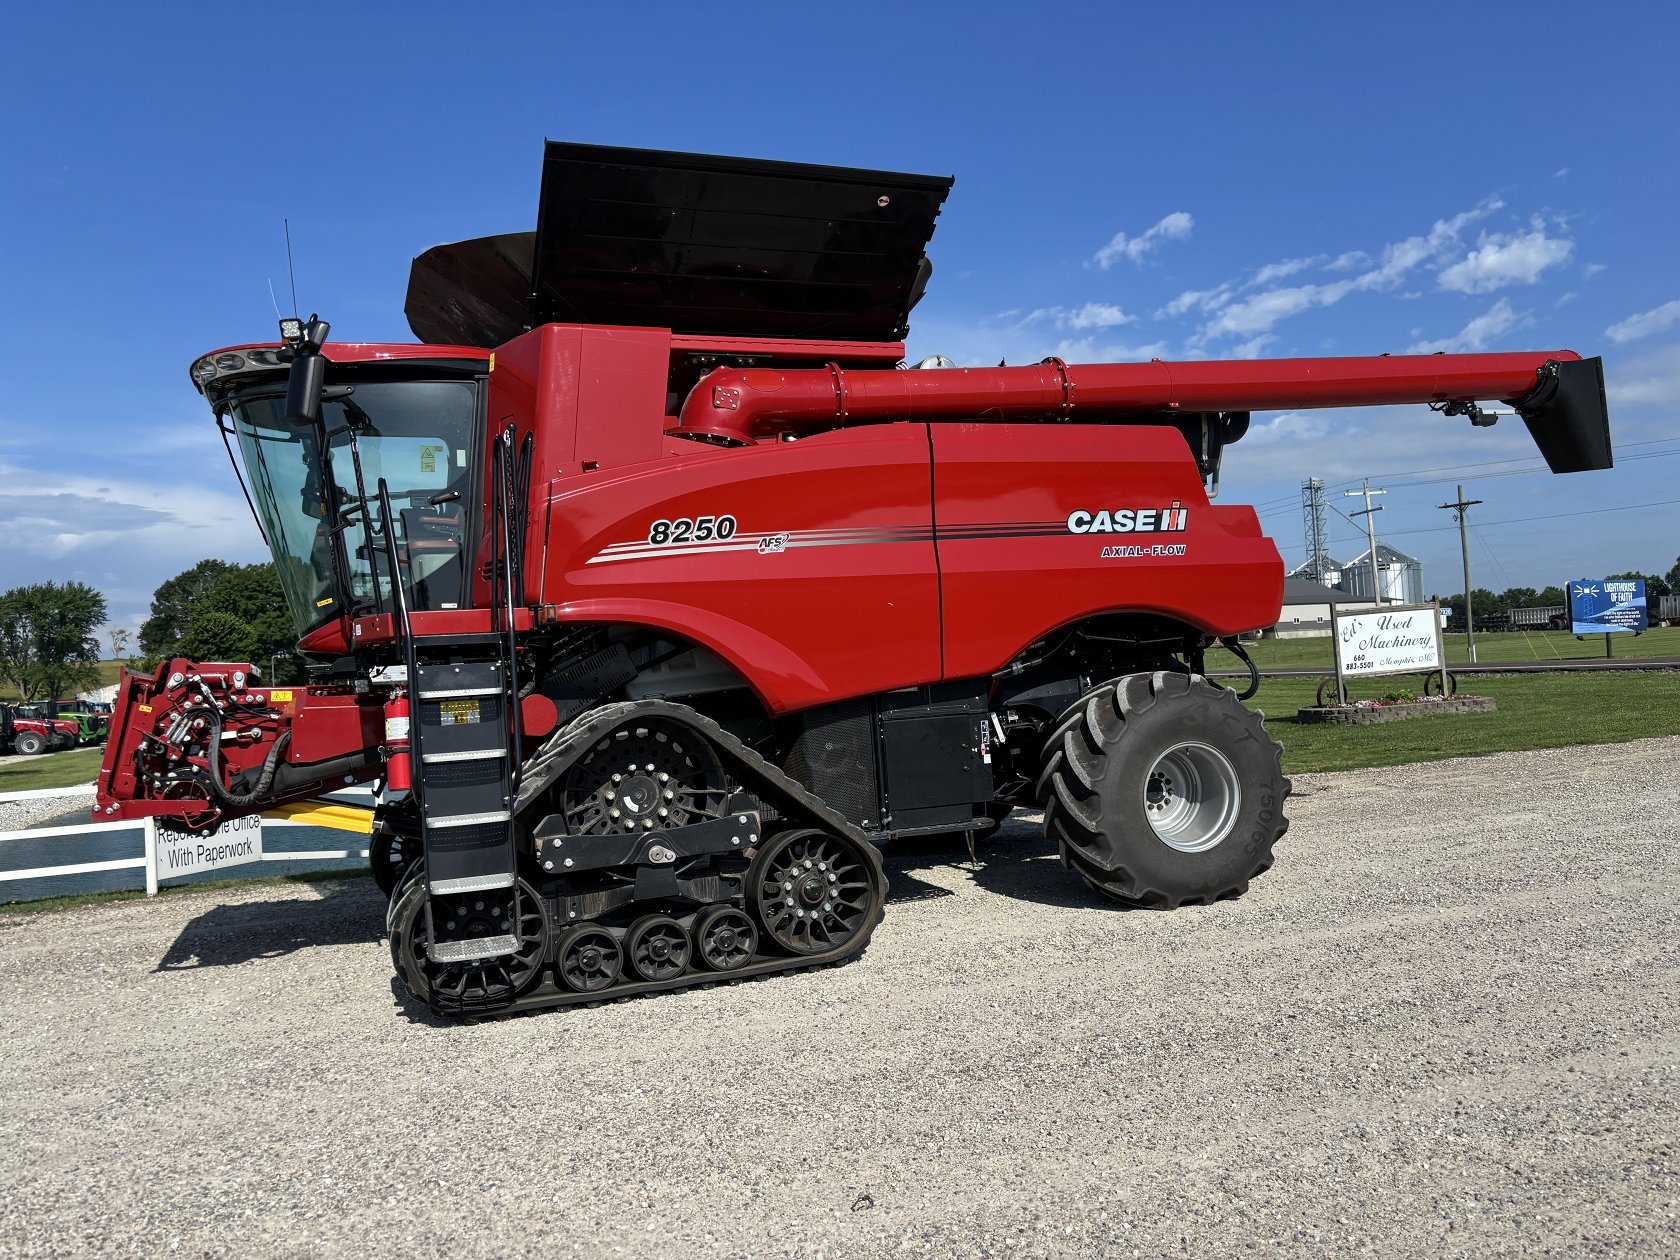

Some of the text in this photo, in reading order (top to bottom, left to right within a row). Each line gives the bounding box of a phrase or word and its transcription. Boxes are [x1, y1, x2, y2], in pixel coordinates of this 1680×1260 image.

[1067, 508, 1157, 534] CASE
[648, 515, 736, 546] 8250
[758, 537, 783, 548] AFS
[1101, 544, 1187, 558] AXIAL-FLOW
[1603, 581, 1637, 593] LIGHTHOUSE
[1610, 592, 1633, 602] OF FAITH
[1340, 615, 1413, 642] Ed's Used
[1359, 634, 1432, 650] Machinery
[1353, 654, 1366, 662] 660
[1345, 661, 1374, 671] 883-5501
[168, 836, 253, 869] With Paperwork
